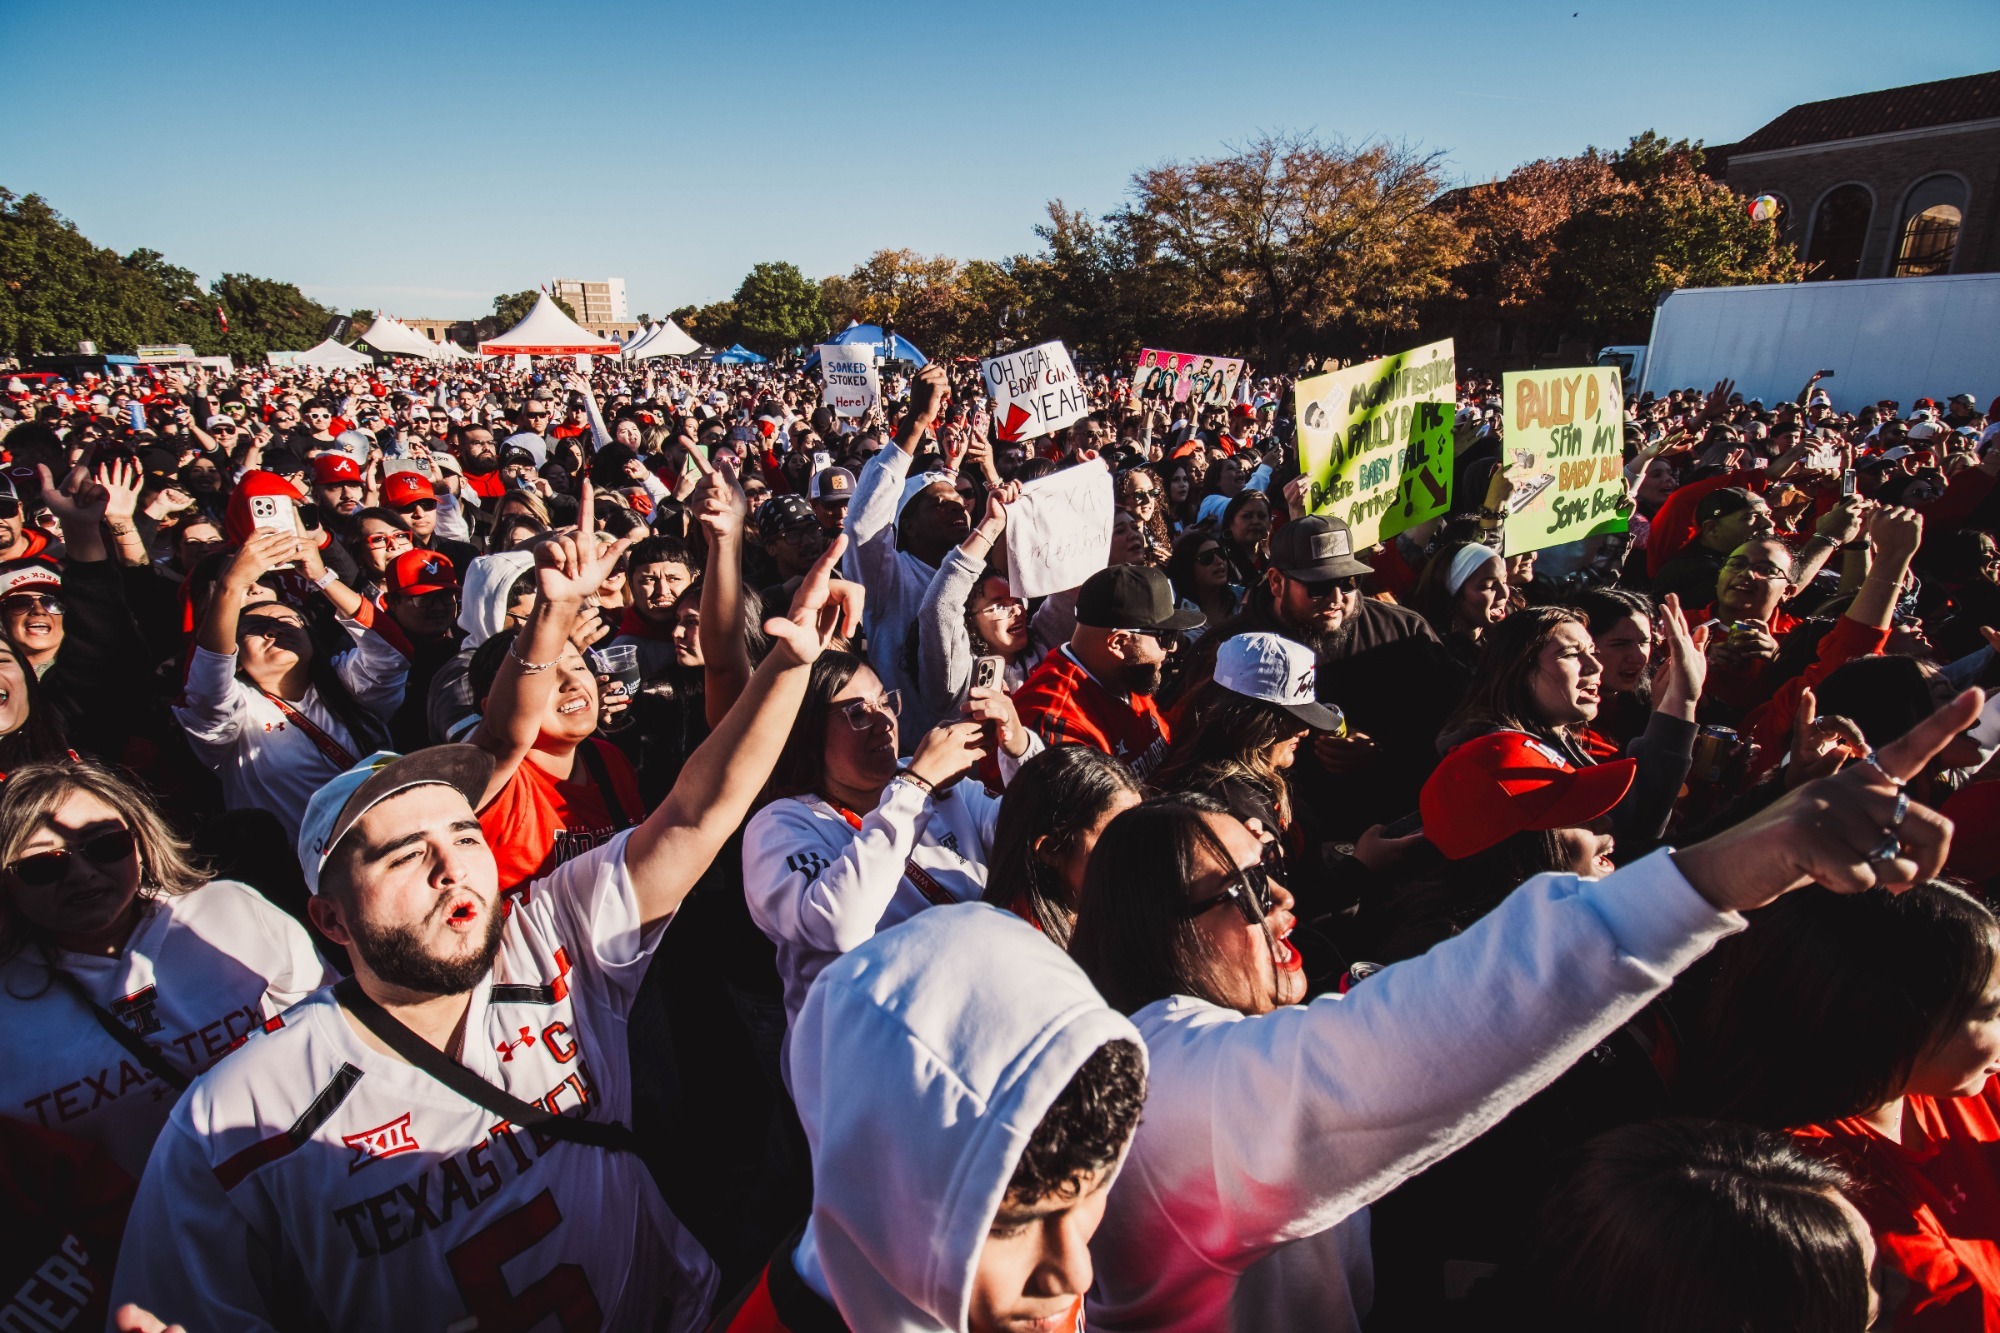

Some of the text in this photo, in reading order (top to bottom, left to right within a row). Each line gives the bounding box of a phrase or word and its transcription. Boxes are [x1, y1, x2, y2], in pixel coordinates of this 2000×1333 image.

[828, 361, 867, 374] SOAKED
[829, 374, 867, 386] STOKED
[989, 359, 1015, 385] OH
[835, 396, 866, 407] Here!
[1030, 385, 1086, 423] YEAH
[1516, 373, 1582, 431] PAULY
[1330, 432, 1344, 467] A
[1347, 405, 1399, 460] PAULY
[1592, 424, 1616, 455] MY
[1311, 473, 1354, 512] Before
[1359, 454, 1393, 492] BABY
[1558, 454, 1624, 492] BABY BUM
[905, 864, 929, 889] WRE
[542, 1021, 578, 1065] C
[24, 1046, 161, 1129] TEXA
[350, 1125, 406, 1164] XII
[333, 1139, 502, 1259] TEXAS
[445, 1187, 604, 1333] 5
